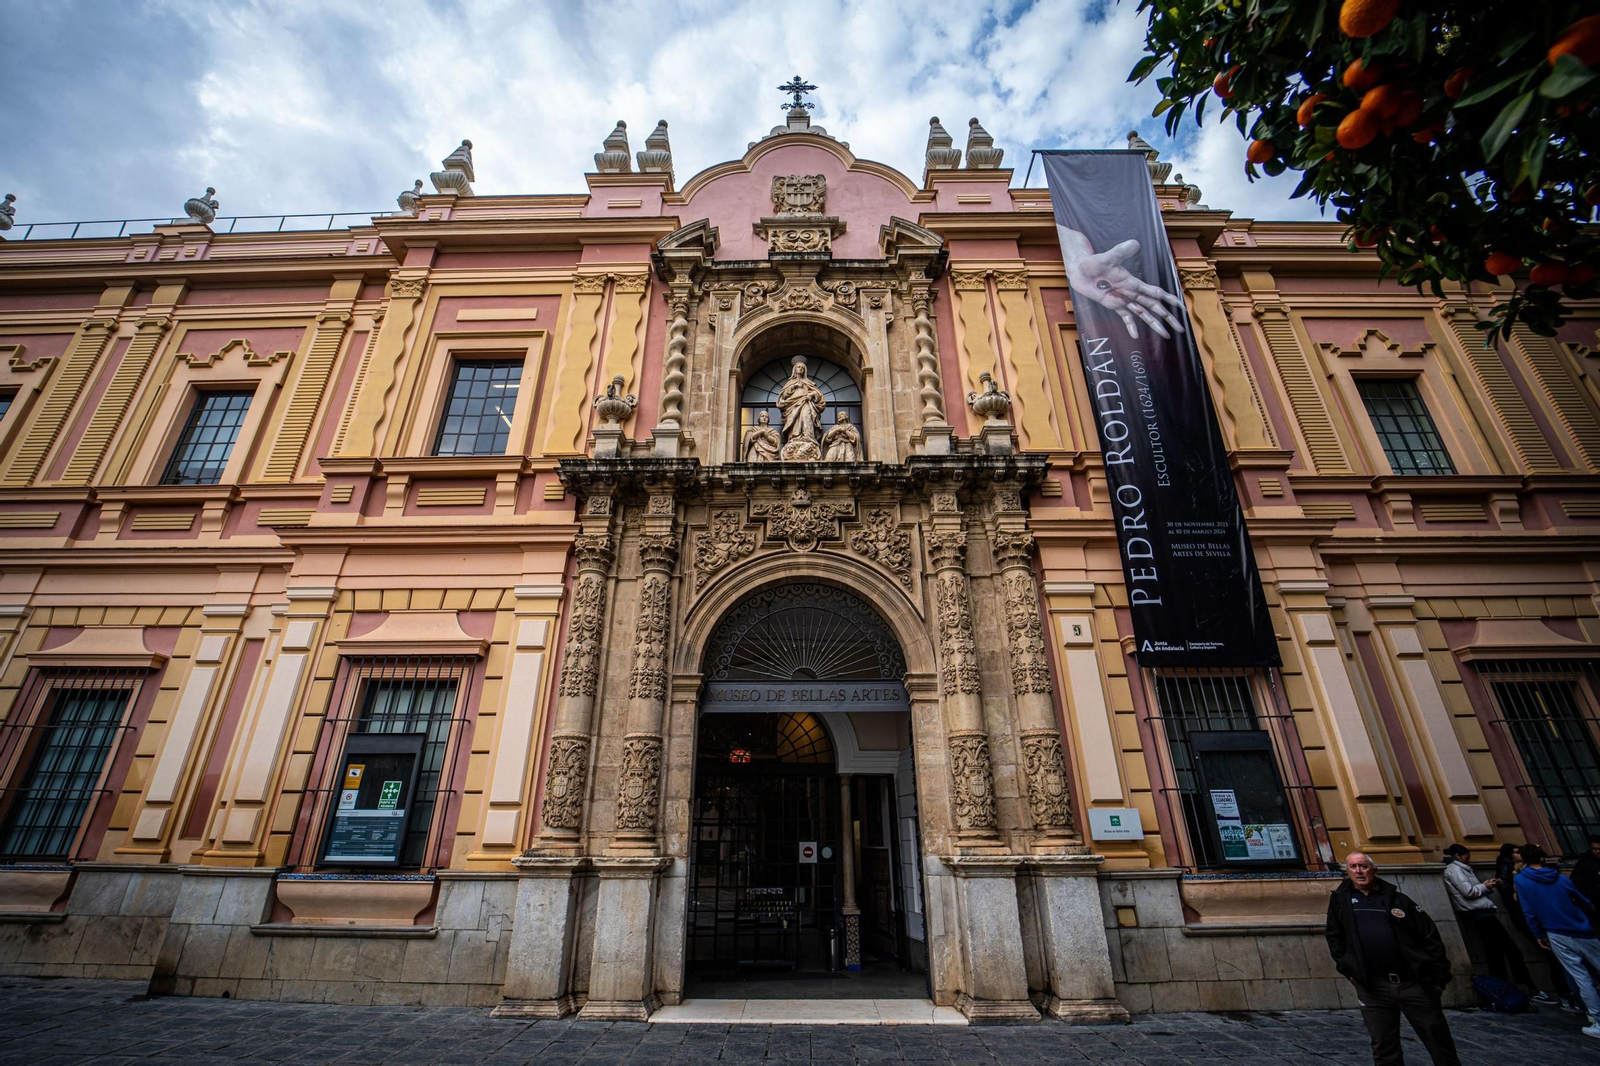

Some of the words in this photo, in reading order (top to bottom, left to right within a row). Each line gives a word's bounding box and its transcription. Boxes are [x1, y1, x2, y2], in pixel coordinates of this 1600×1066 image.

[1087, 336, 1135, 467] ROLDÁN
[1131, 350, 1154, 419] (1624/1699)
[1147, 422, 1171, 488] ESCULTOR
[1116, 484, 1162, 607] PEDRO
[710, 689, 761, 702] MUSEO
[766, 690, 786, 702] DE
[792, 689, 846, 702] BELLAS
[852, 688, 900, 700] ARTES
